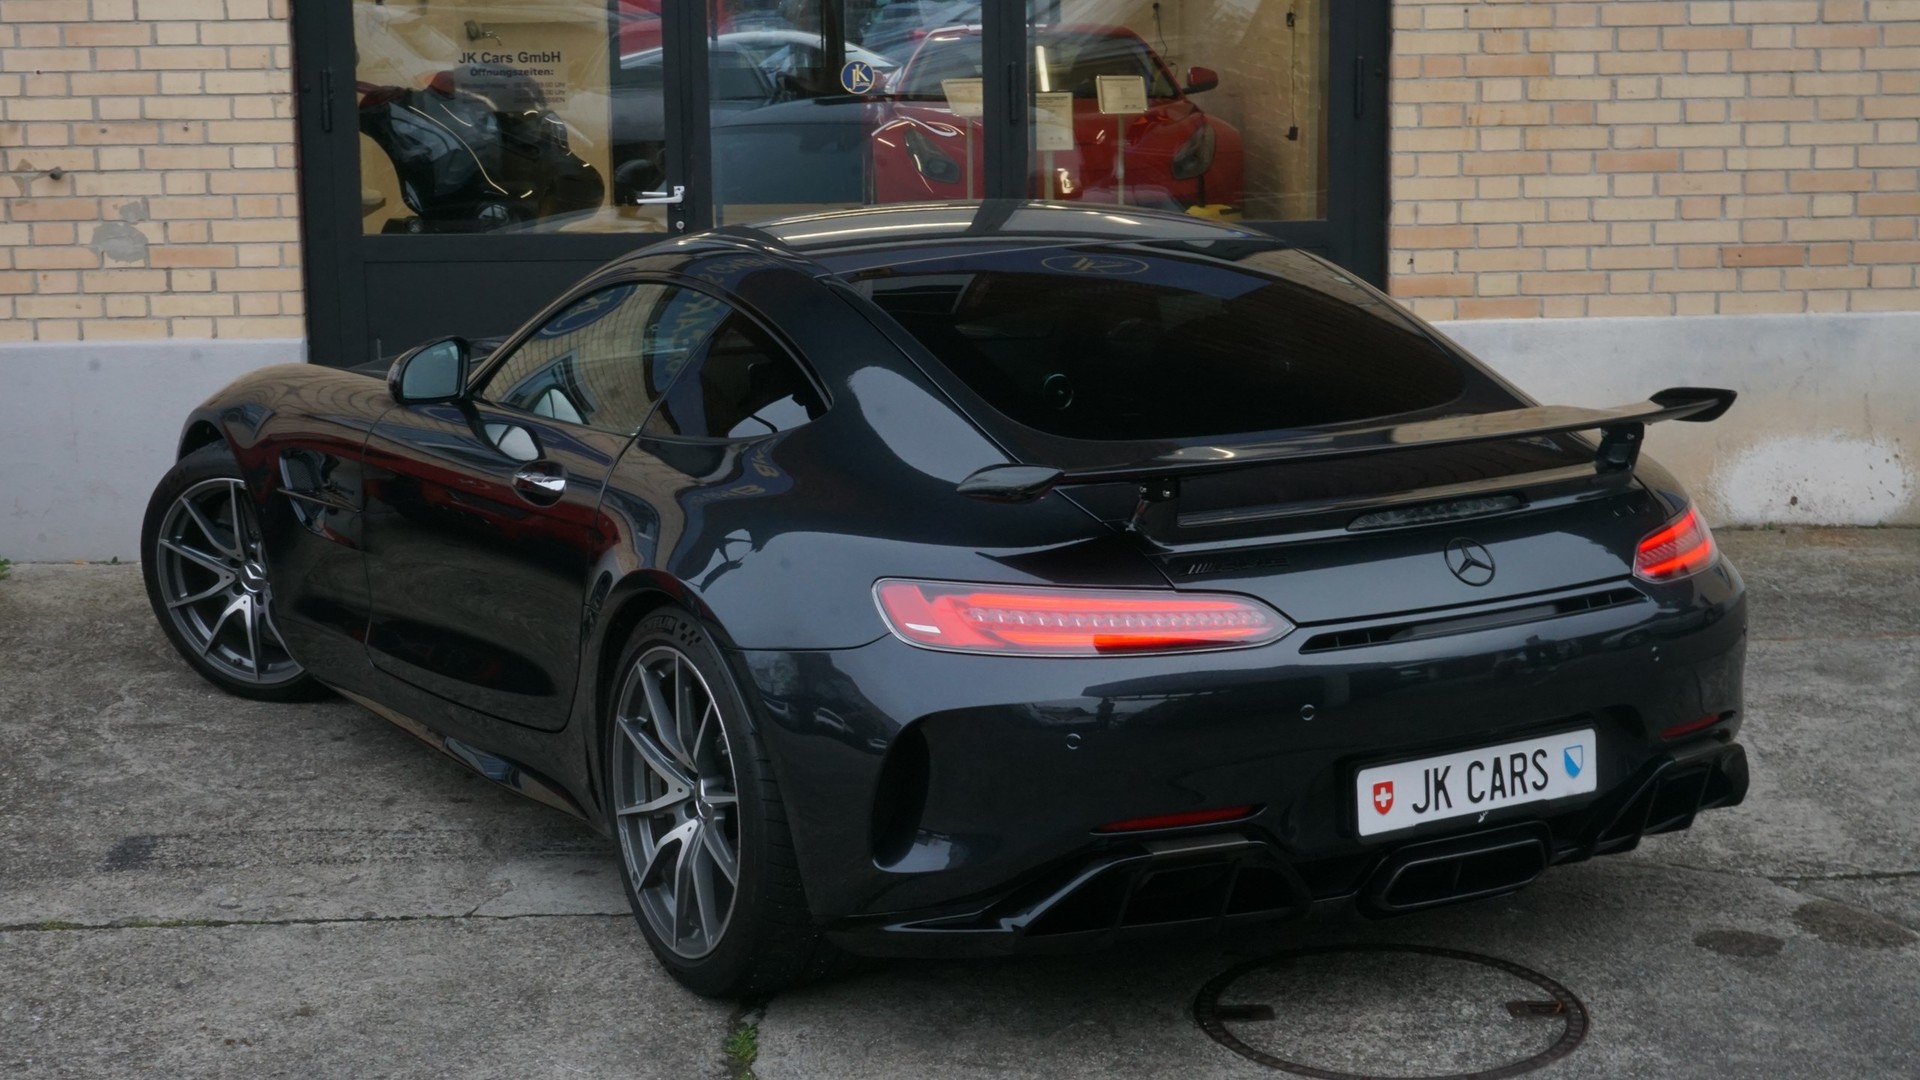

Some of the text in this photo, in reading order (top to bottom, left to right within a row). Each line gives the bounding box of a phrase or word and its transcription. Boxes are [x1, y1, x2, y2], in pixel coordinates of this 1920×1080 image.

[458, 51, 561, 64] JK Cars GmbH
[470, 67, 554, 78] Öffnungszeiten:
[1412, 748, 1549, 814] JK CARS
